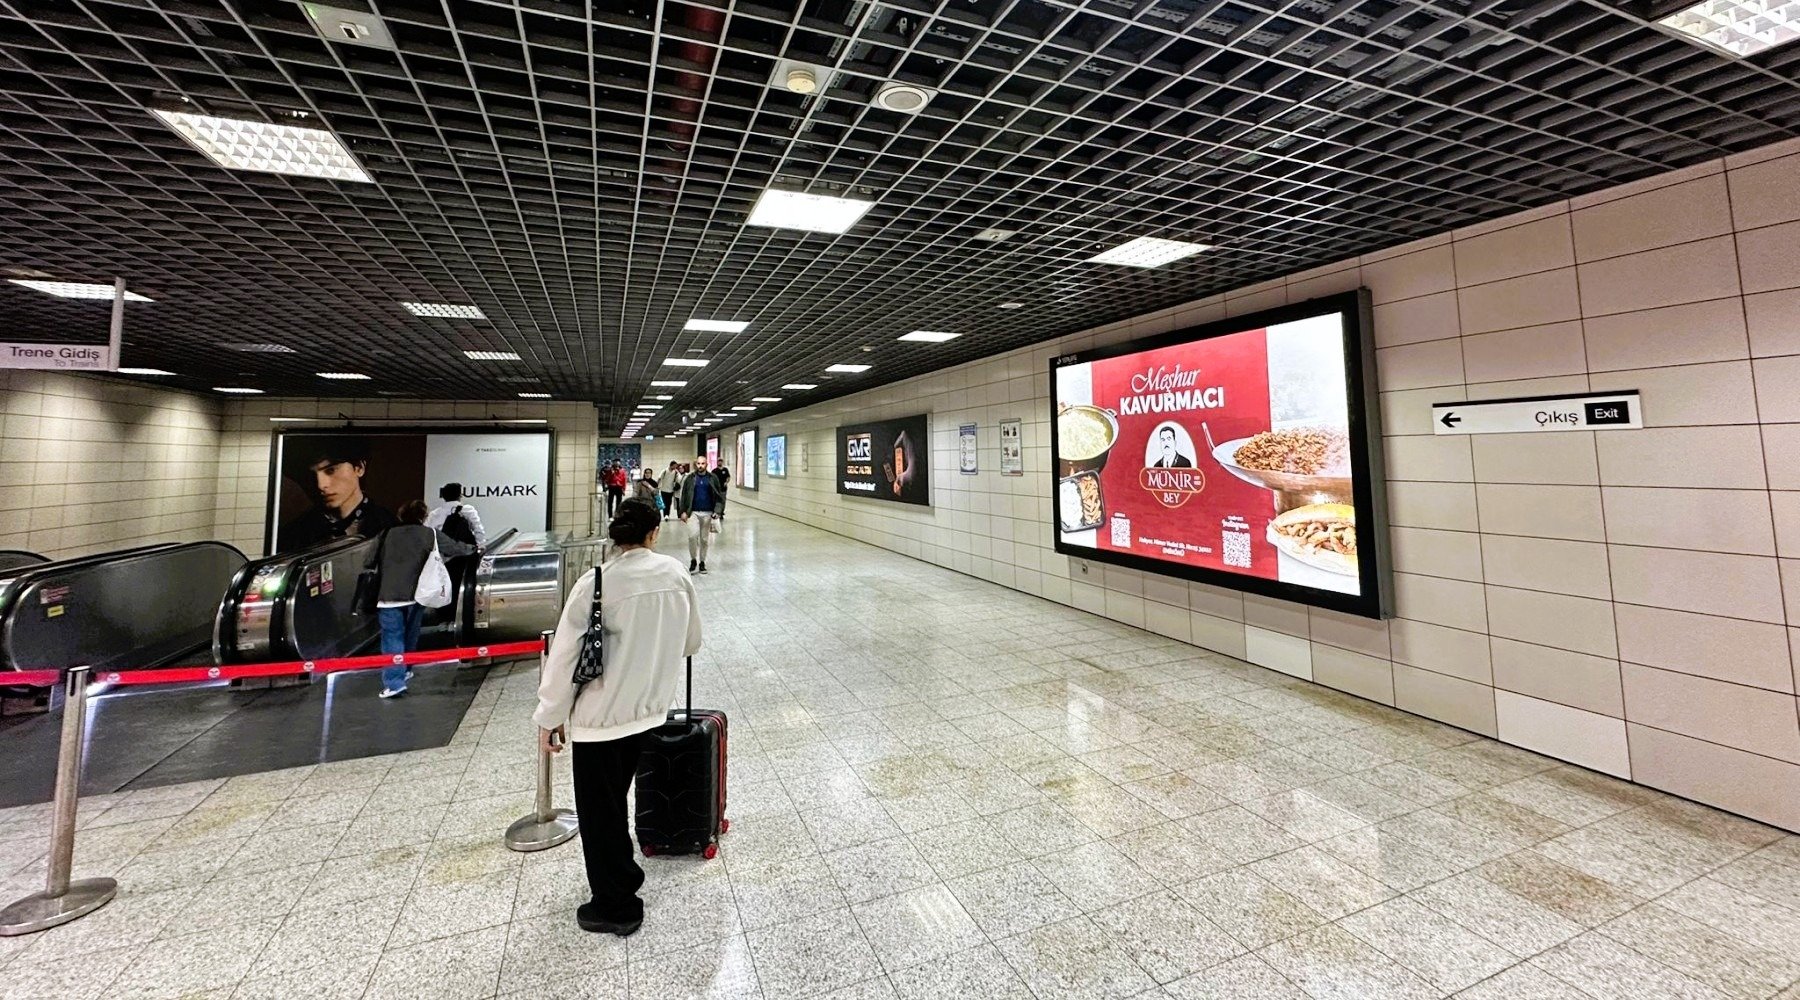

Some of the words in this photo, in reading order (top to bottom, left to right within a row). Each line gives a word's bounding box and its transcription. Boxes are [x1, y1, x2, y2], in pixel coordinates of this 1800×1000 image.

[10, 346, 54, 358] Trene
[59, 347, 100, 361] Gidiş
[1131, 363, 1201, 393] Meşhur
[1120, 386, 1225, 416] KAVURMACI
[1535, 411, 1579, 426] Çıkış
[1594, 408, 1619, 419] Exit
[1147, 470, 1198, 492] MÜNİR
[440, 484, 538, 499] ULMARK
[1163, 492, 1181, 504] BEY
